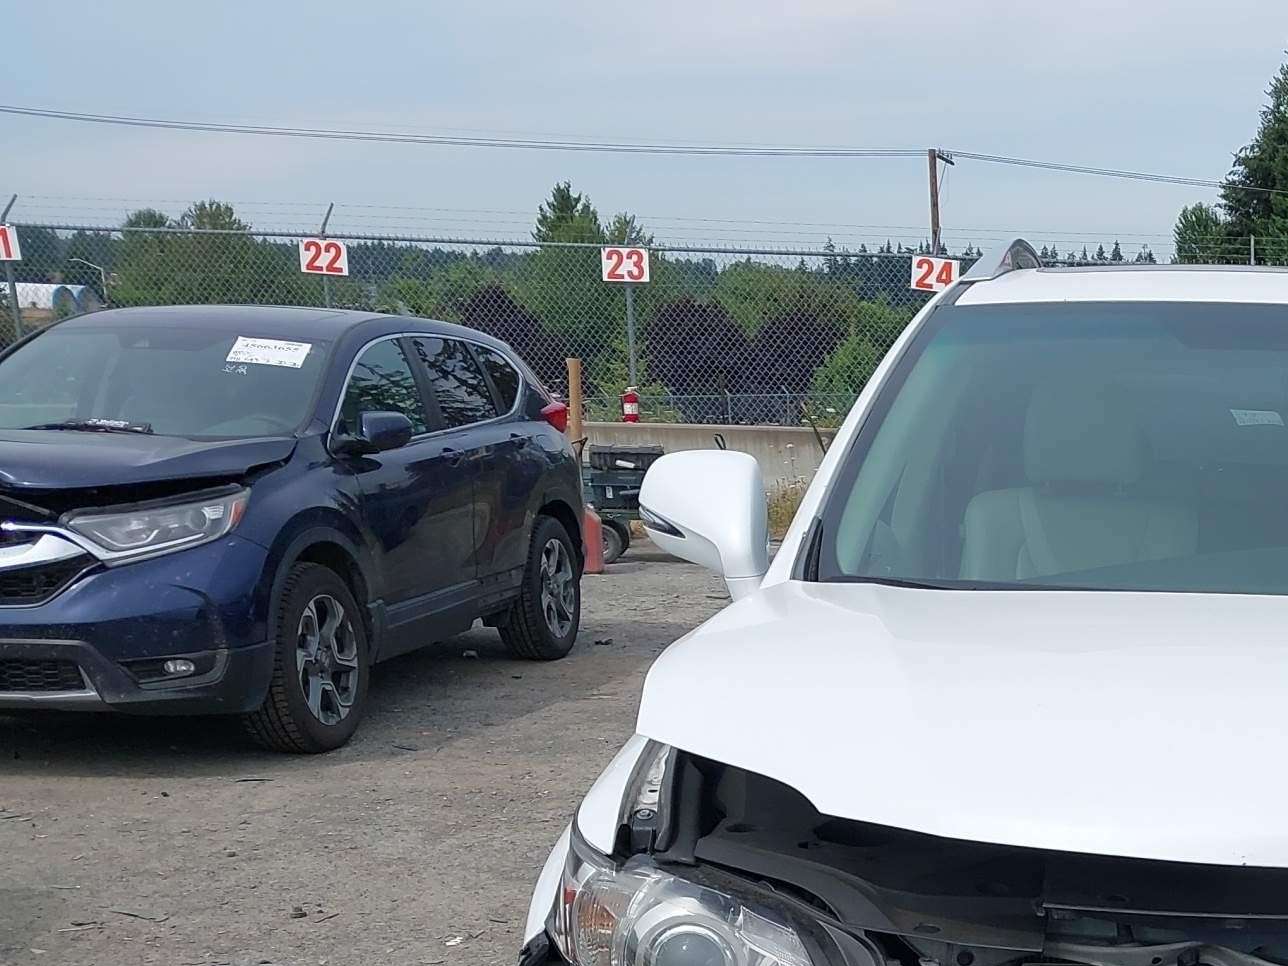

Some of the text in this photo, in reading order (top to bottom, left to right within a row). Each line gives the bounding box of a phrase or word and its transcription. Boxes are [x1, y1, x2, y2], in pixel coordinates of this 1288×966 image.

[304, 241, 343, 273] 22
[606, 250, 644, 280] 23
[916, 259, 952, 289] 24
